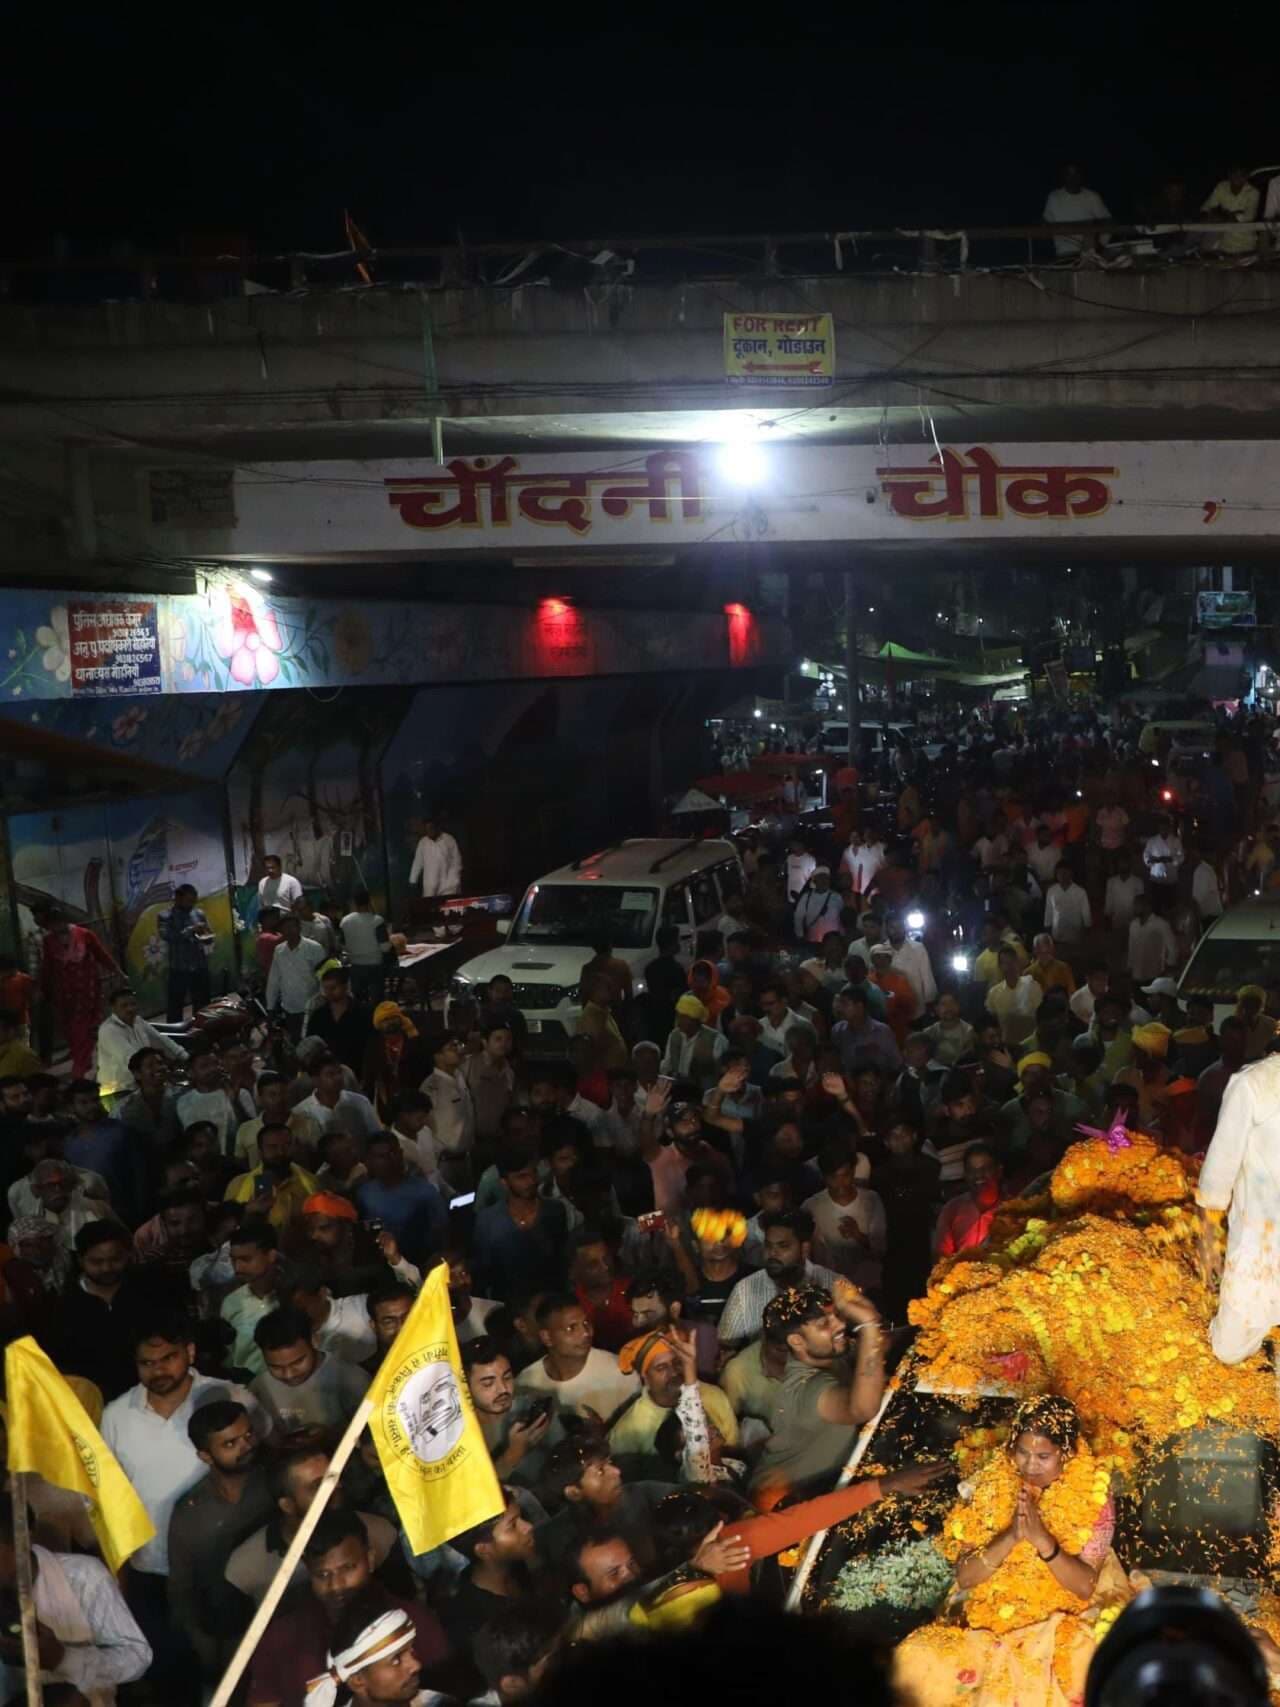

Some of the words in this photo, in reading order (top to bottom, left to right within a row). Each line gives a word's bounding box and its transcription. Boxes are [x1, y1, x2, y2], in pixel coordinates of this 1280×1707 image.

[733, 316, 769, 333] FOR
[384, 451, 703, 535] चाँदनी
[876, 447, 1117, 519] चौक
